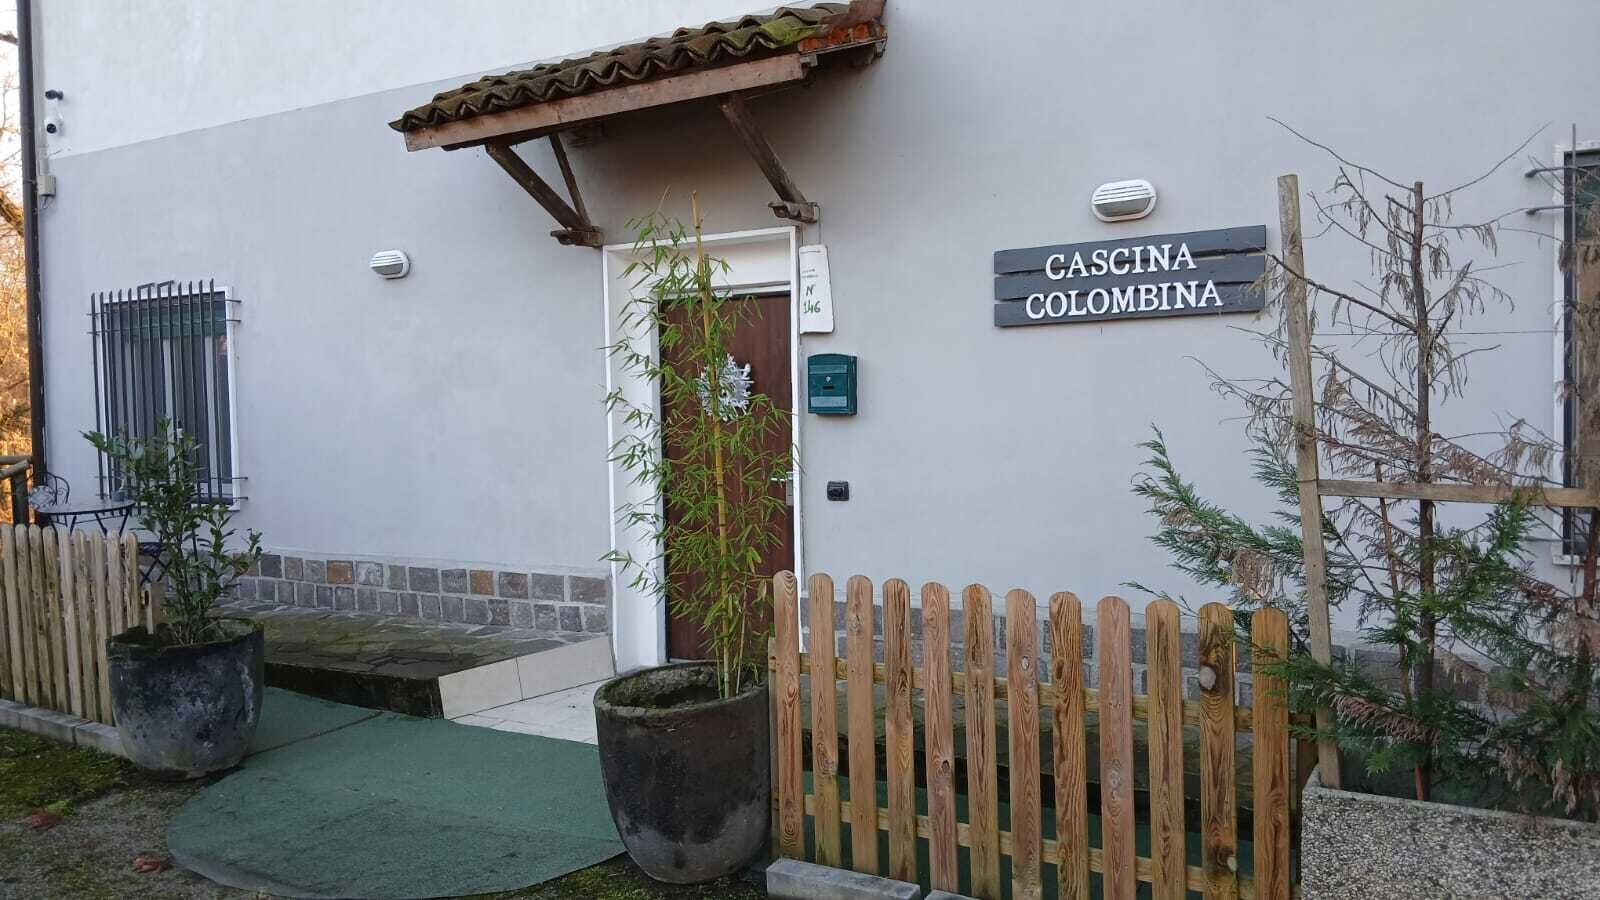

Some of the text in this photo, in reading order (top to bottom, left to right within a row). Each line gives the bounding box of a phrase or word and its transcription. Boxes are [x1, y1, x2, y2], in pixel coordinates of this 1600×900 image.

[1045, 242, 1197, 280] CASCINA
[803, 299, 821, 314] 146
[1025, 279, 1224, 319] COLOMBINA
